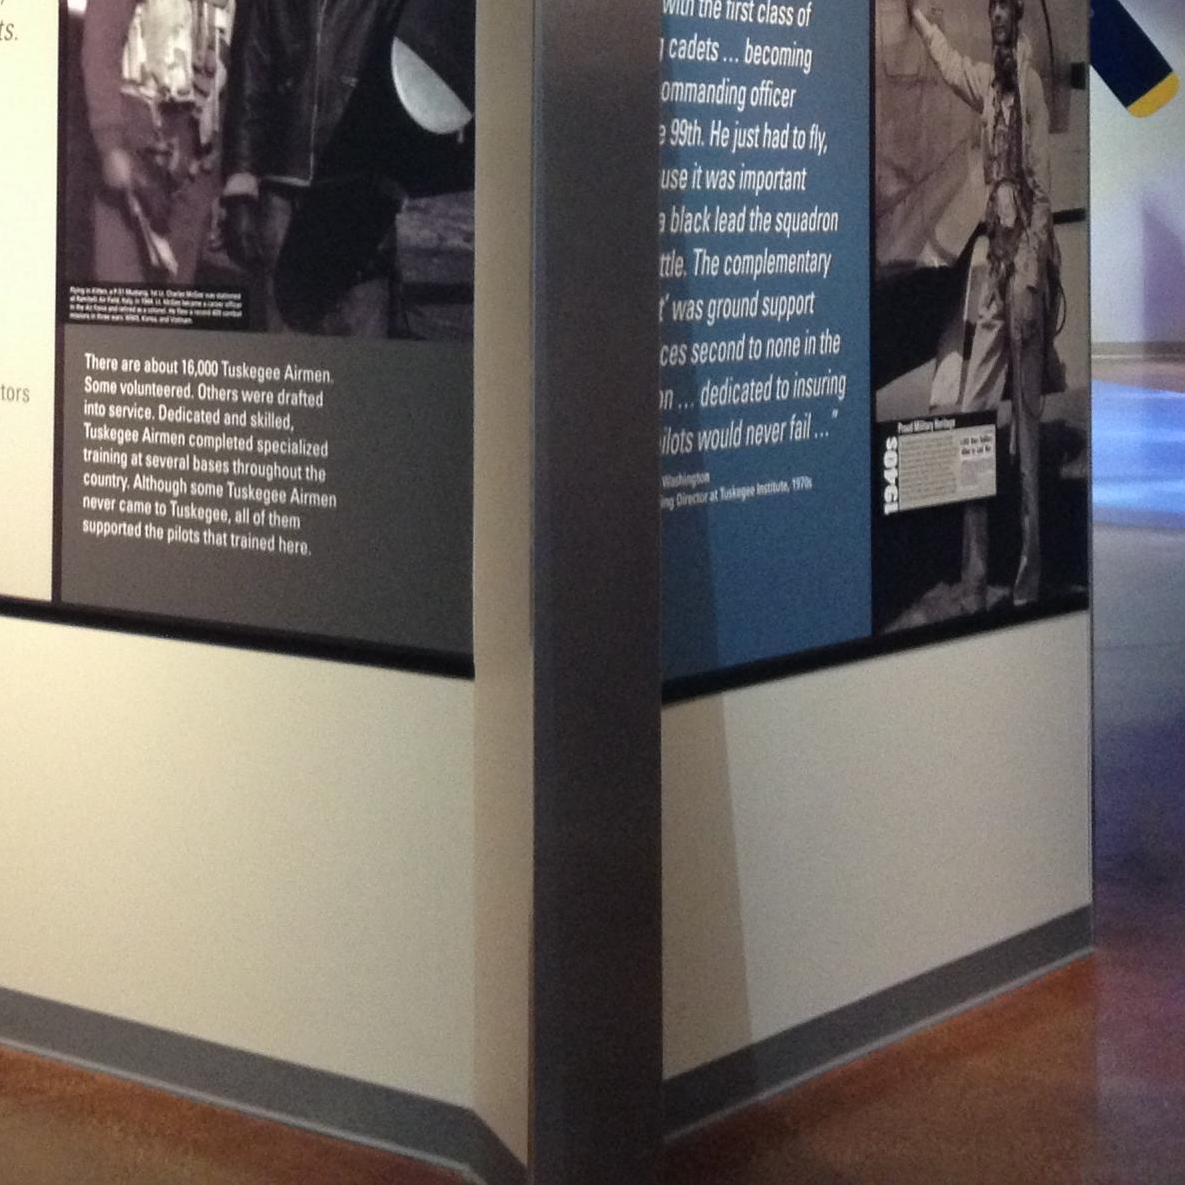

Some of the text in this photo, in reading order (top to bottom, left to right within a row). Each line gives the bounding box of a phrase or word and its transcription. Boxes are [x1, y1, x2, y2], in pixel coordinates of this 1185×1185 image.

[796, 1, 812, 27] of
[750, 80, 796, 107] officer
[670, 118, 827, 155] 99th. He just had to fly,
[670, 206, 838, 237] black lead the squadron
[694, 247, 831, 280] The complementary
[84, 352, 334, 384] There are about 16,000 Tuskegee Airmen.
[84, 375, 323, 407] Some volunteered. Others were drafted
